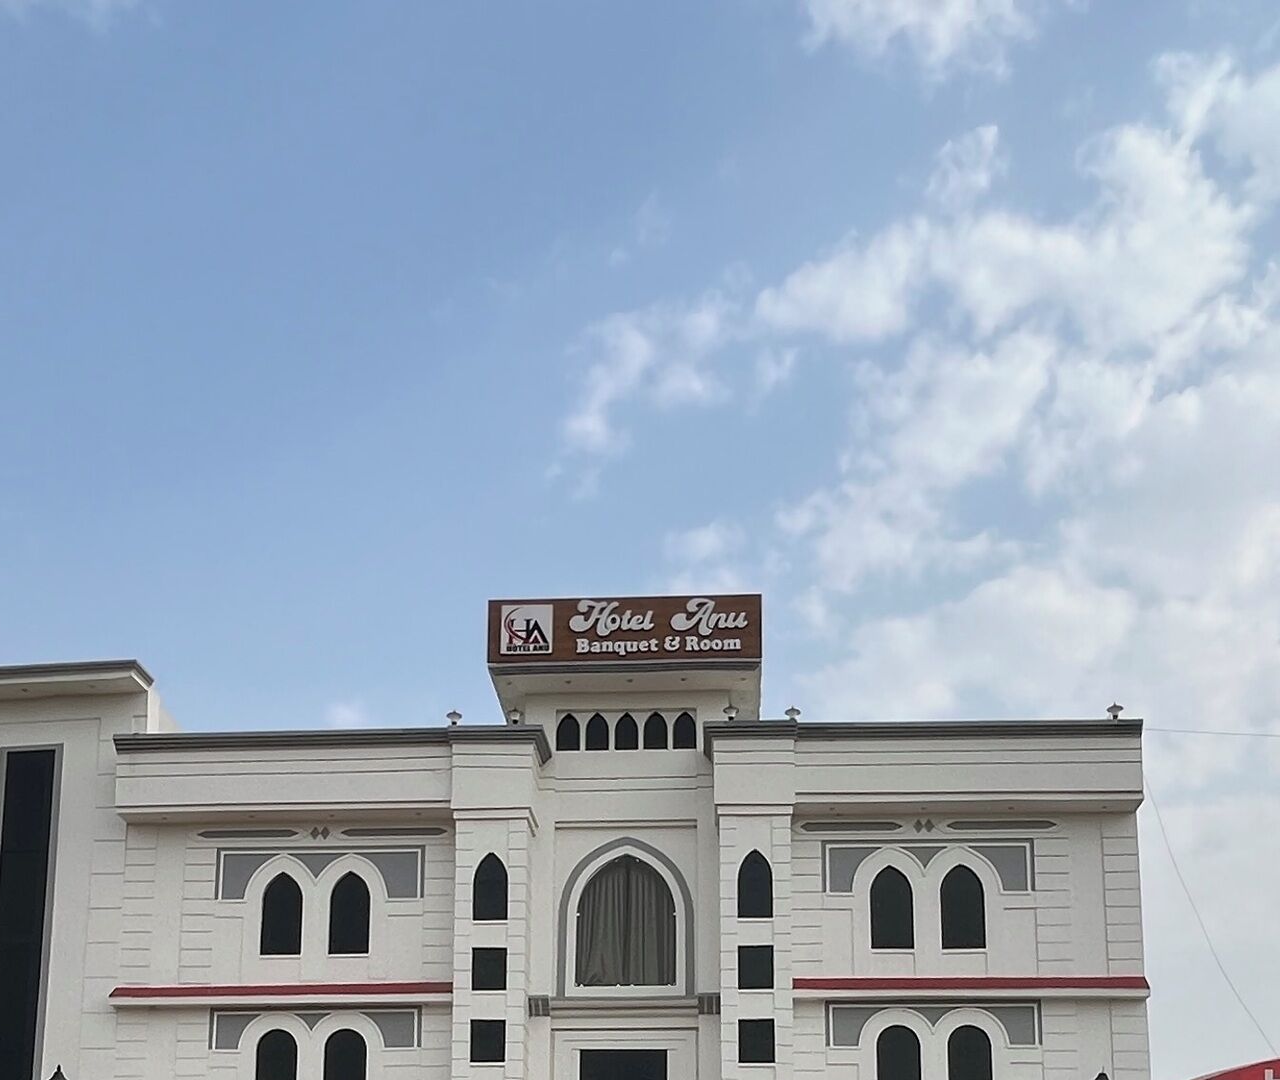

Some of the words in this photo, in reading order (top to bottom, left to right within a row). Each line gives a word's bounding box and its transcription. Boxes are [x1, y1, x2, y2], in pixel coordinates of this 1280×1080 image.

[569, 599, 655, 637] Hotel
[670, 598, 748, 636] Anu
[576, 638, 659, 656] Banquet
[663, 636, 681, 651] &
[685, 635, 742, 651] Room
